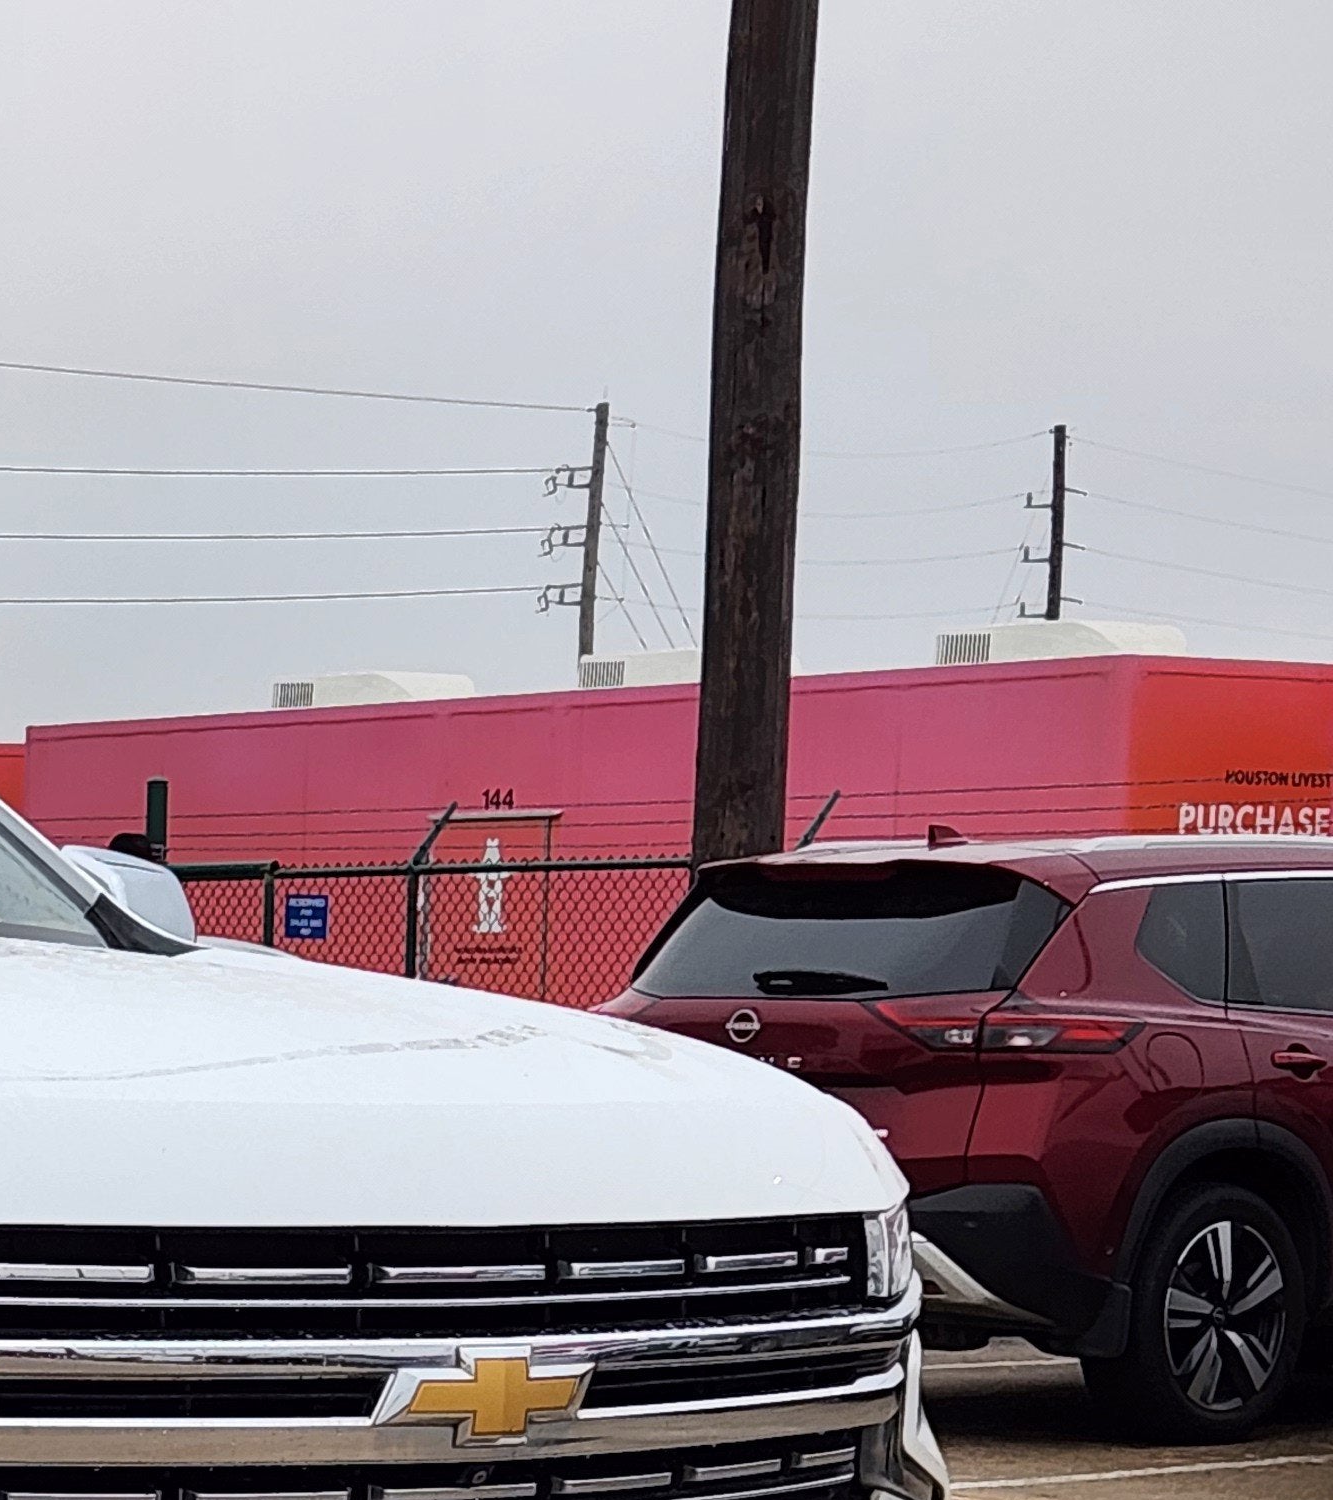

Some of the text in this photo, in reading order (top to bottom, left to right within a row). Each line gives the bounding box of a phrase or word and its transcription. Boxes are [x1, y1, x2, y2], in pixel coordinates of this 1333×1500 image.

[1225, 769, 1289, 785] HOUSTON
[482, 788, 514, 810] 144
[1178, 803, 1331, 835] PURCHASE
